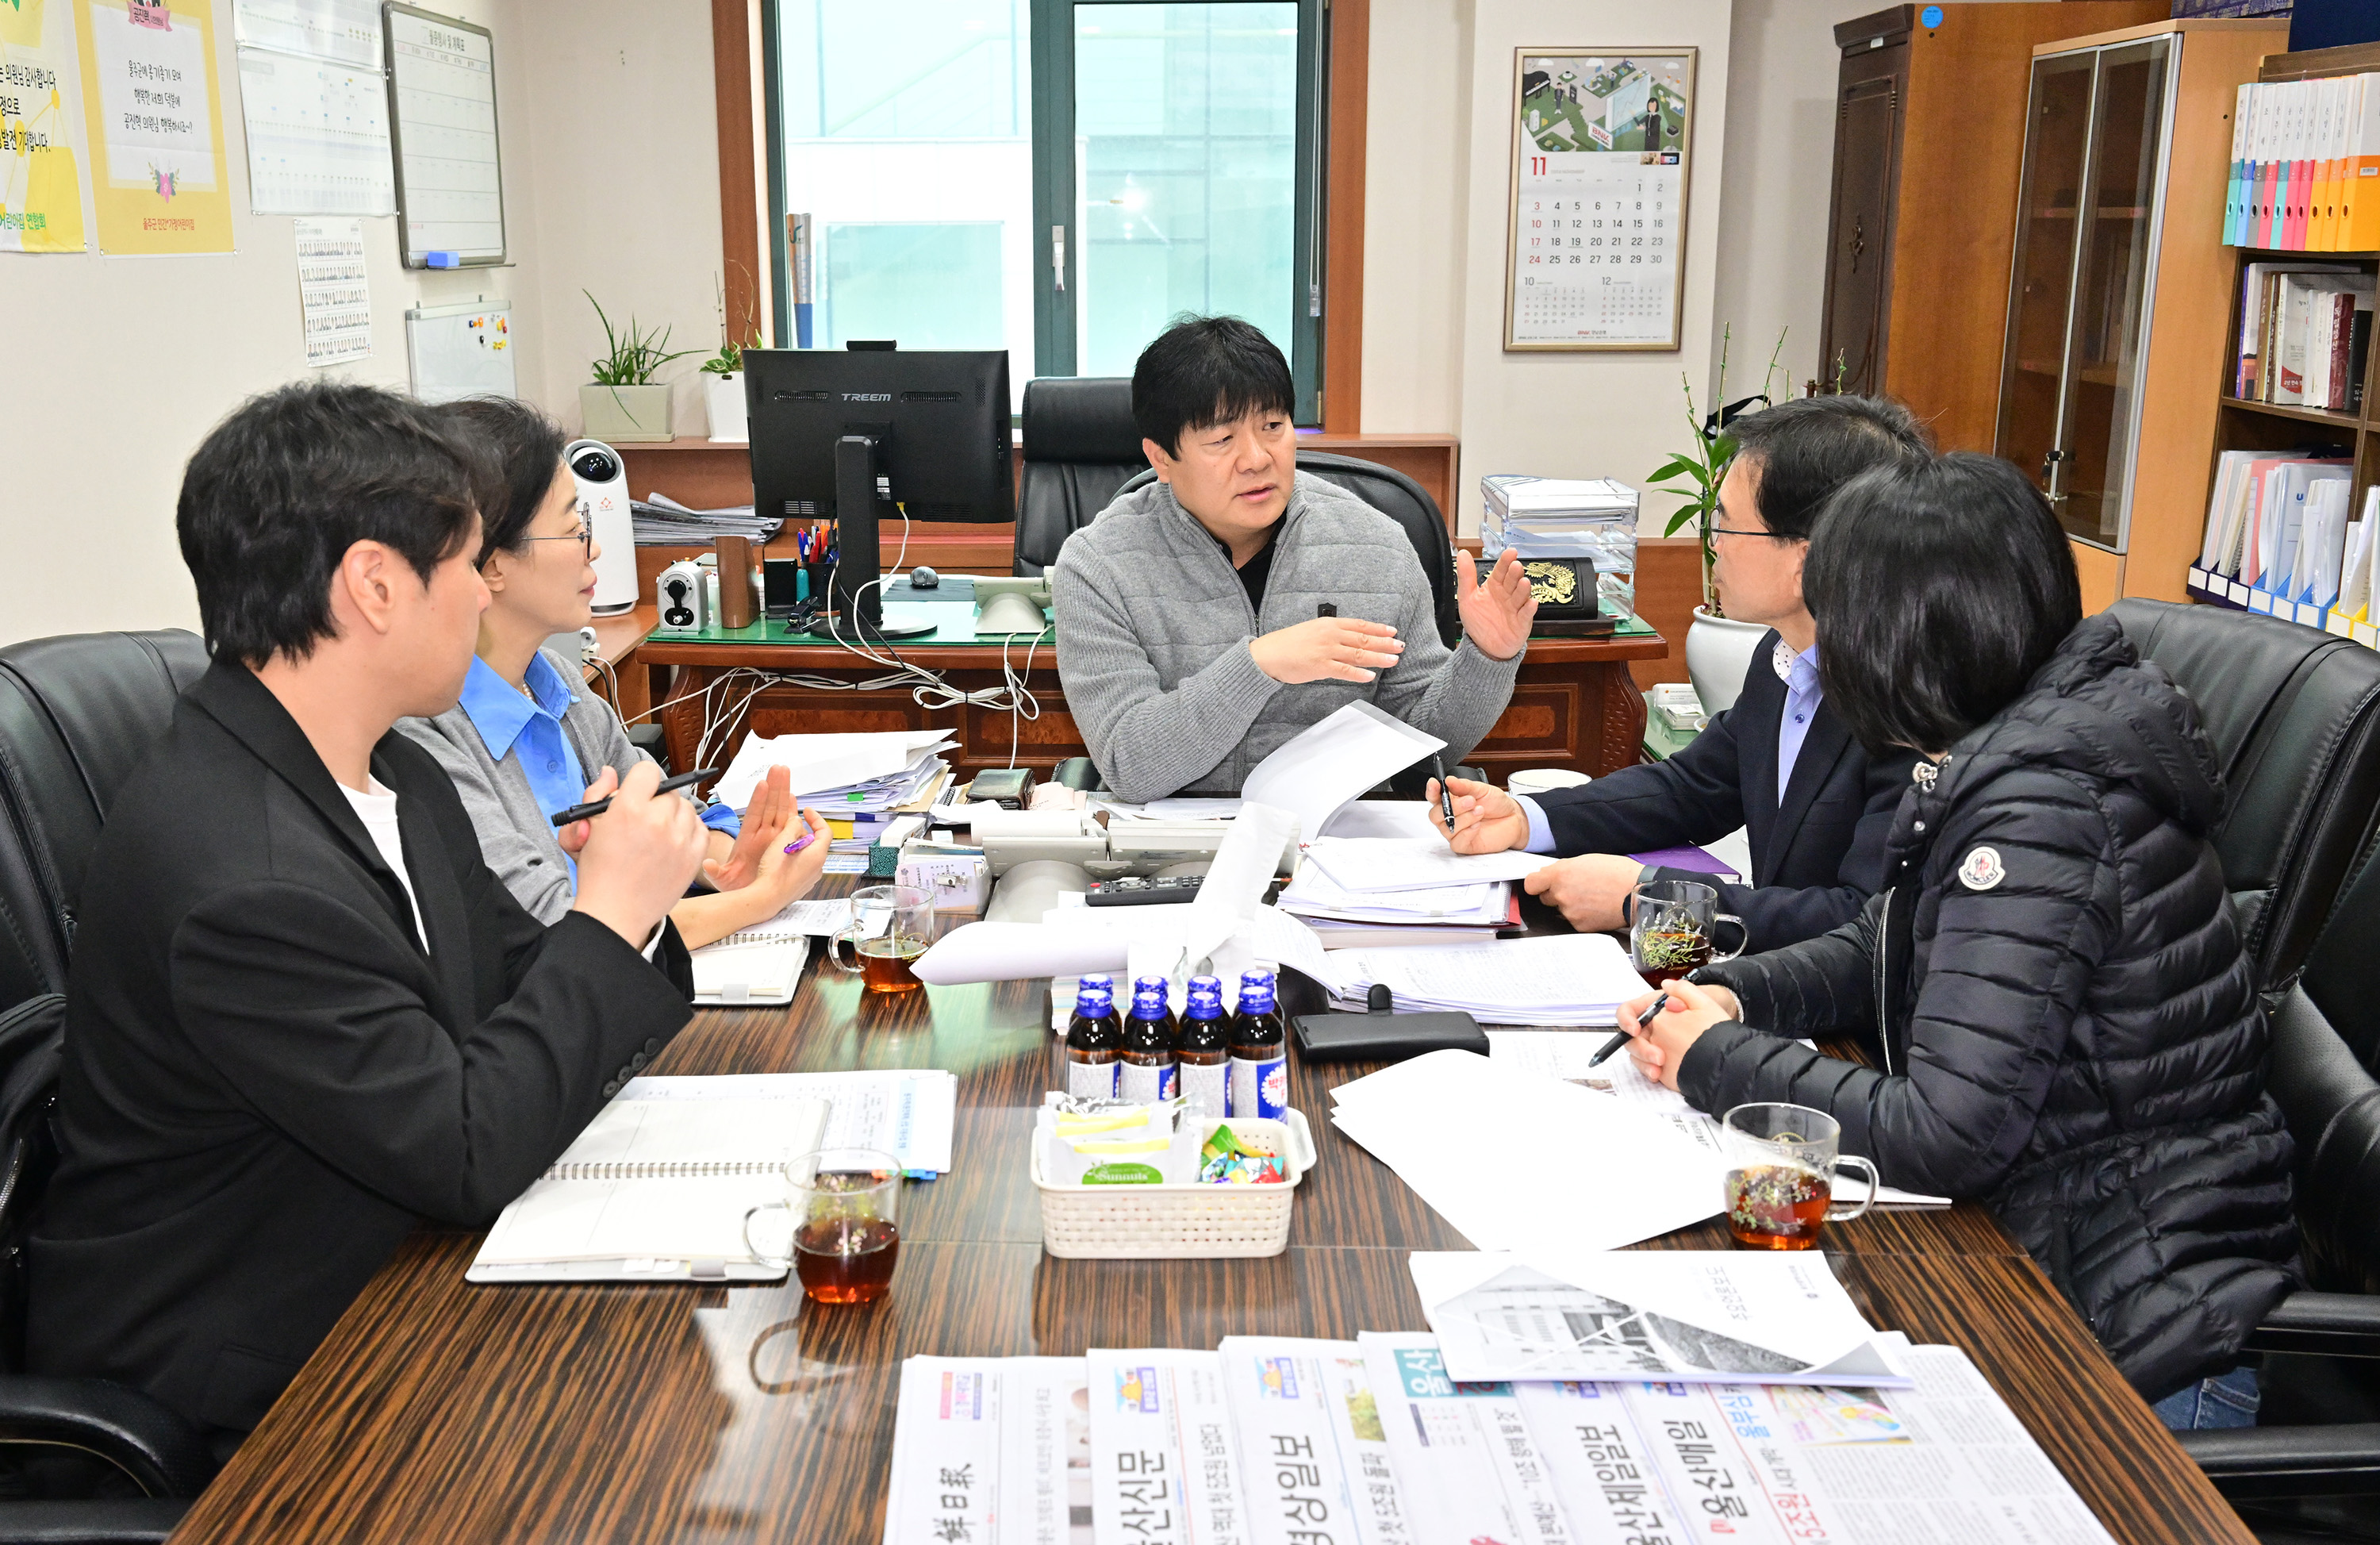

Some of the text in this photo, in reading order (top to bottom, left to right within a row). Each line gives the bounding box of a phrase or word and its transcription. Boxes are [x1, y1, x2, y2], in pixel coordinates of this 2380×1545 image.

[133, 7, 149, 23] 공진혁
[6, 63, 24, 86] 의원님
[25, 66, 56, 90] 감사합니다
[129, 60, 182, 82] 울주군에 옹기종기 모여
[134, 87, 181, 109] 행복한 저희 덕분에
[124, 113, 141, 130] 공진혁
[143, 116, 159, 133] 의원님
[1531, 157, 1546, 175] 11
[26, 212, 46, 230] 연합회
[1525, 277, 1611, 286] 10 12
[841, 393, 892, 402] TREEM
[1718, 1394, 1771, 1439] 울부심
[1663, 1420, 1749, 1519] 울산매일
[1118, 1450, 1174, 1545] 산신문
[1773, 1492, 1827, 1539] 5조원
